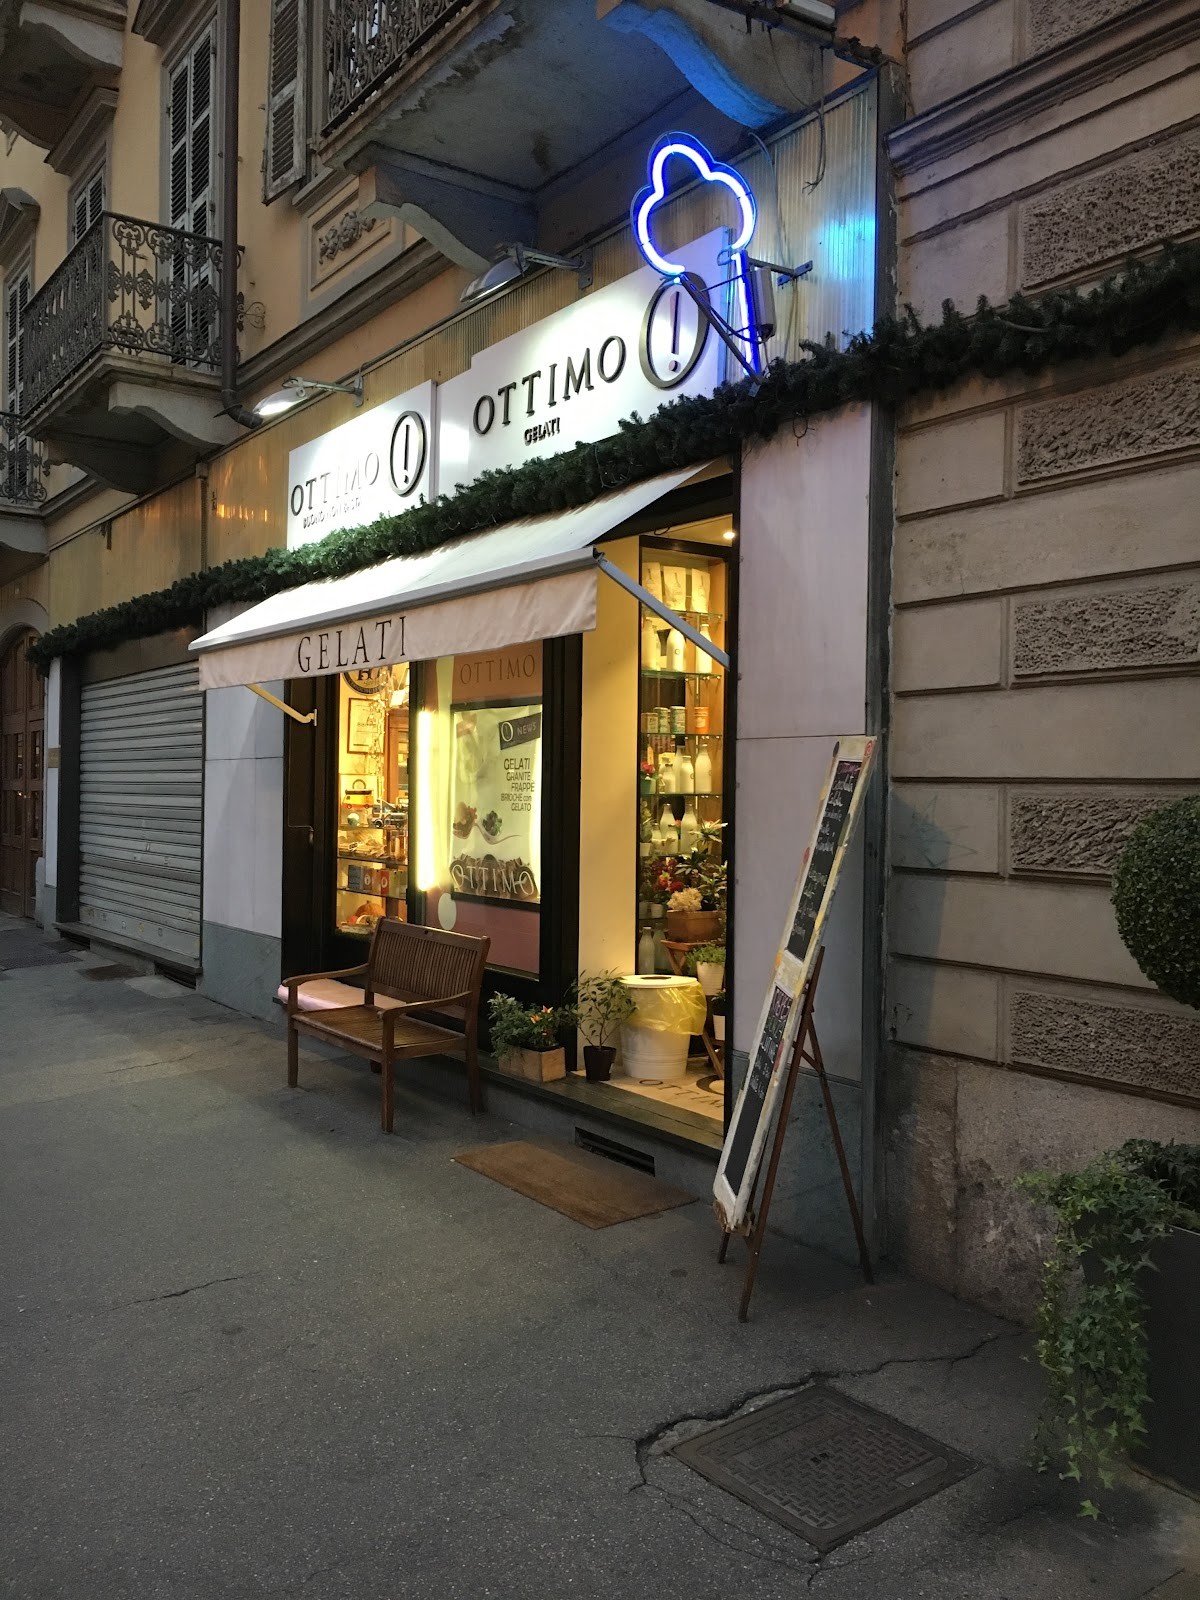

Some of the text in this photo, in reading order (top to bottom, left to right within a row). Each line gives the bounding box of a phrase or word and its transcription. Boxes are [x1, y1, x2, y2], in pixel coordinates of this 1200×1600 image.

[472, 335, 627, 436] OTTIMO
[523, 416, 561, 446] GELATI
[290, 452, 379, 516] OTTIMO
[297, 615, 407, 674] GELATI
[460, 653, 536, 685] OTTIMO
[516, 721, 537, 736] NEWS
[503, 757, 531, 771] GELATI
[506, 771, 531, 782] GRANITE
[500, 793, 522, 802] BRIOCHE
[511, 802, 532, 812] GELATO
[451, 864, 535, 896] OTTIMO
